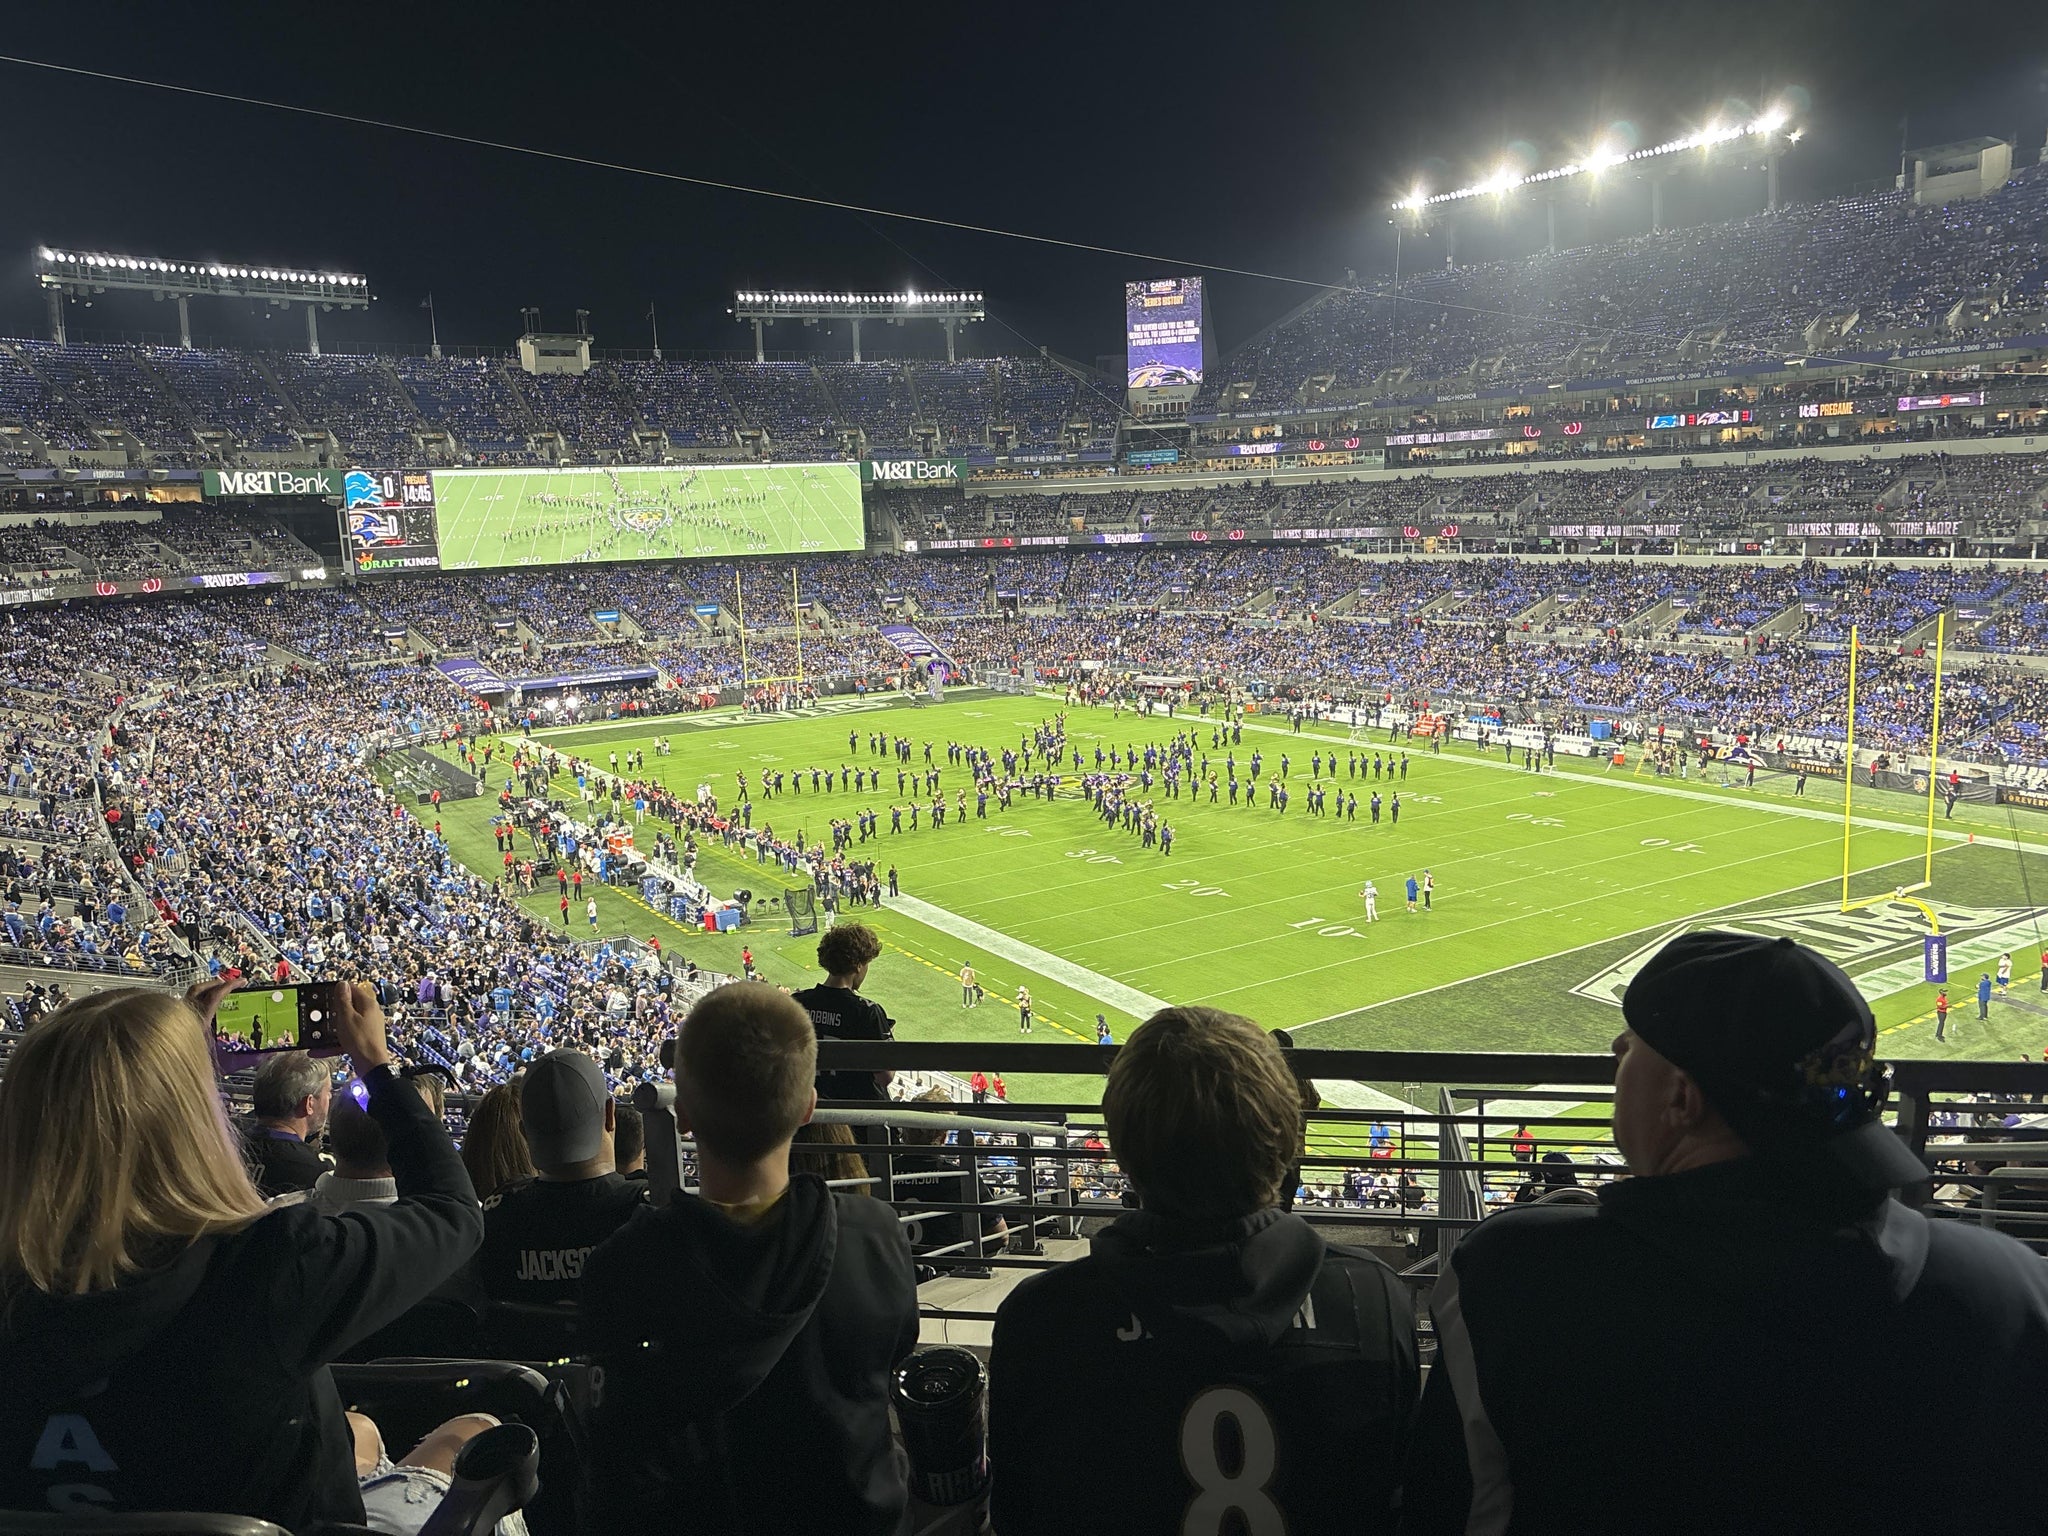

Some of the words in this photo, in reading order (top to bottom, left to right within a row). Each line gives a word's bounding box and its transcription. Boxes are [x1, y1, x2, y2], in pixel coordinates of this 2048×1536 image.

[1921, 346, 1961, 356] CHAMPIONS
[1962, 344, 1980, 352] 2000
[1986, 341, 2004, 350] 2012
[1645, 375, 1676, 384] CHAMPIONS
[1819, 402, 1854, 416] PREGAME
[871, 461, 916, 480] M&T
[916, 461, 958, 479] Bank
[217, 471, 277, 494] M&T
[279, 471, 331, 493] Bank
[404, 475, 428, 485] PREGAME
[403, 485, 431, 503] 14:45
[1585, 525, 1605, 536] THERE
[1606, 525, 1621, 536] AND
[1623, 524, 1653, 536] NOTHING
[1834, 523, 1859, 536] THERE
[360, 556, 438, 572] DRAFTKINGS
[202, 573, 249, 588] RAVENS
[684, 700, 893, 727] RAVENS
[1065, 849, 1116, 864] 30
[1161, 879, 1225, 897] 20
[1287, 917, 1358, 937] 10
[806, 1009, 841, 1027] OBBINS
[516, 1246, 598, 1281] JACKS
[1177, 1383, 1291, 1536] 8
